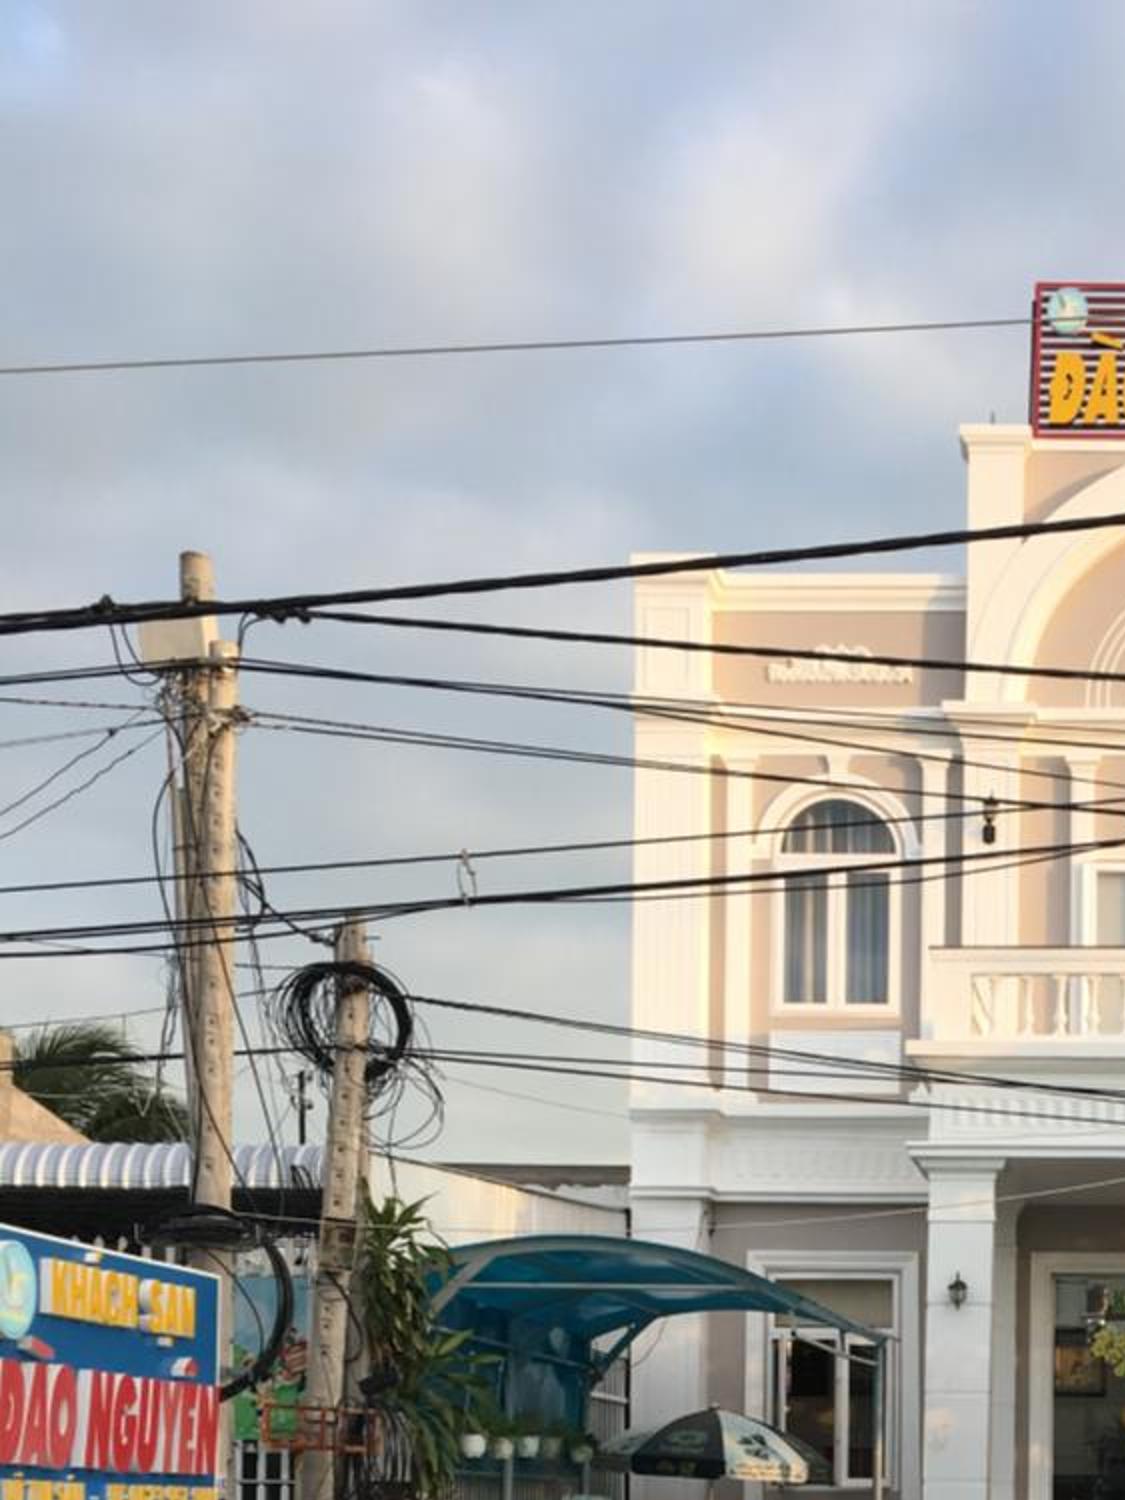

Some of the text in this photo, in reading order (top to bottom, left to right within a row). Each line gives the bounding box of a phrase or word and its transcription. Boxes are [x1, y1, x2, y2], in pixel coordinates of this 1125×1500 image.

[40, 1250, 196, 1347] KHÁCH SẠN
[83, 1357, 222, 1477] NGUYÊN
